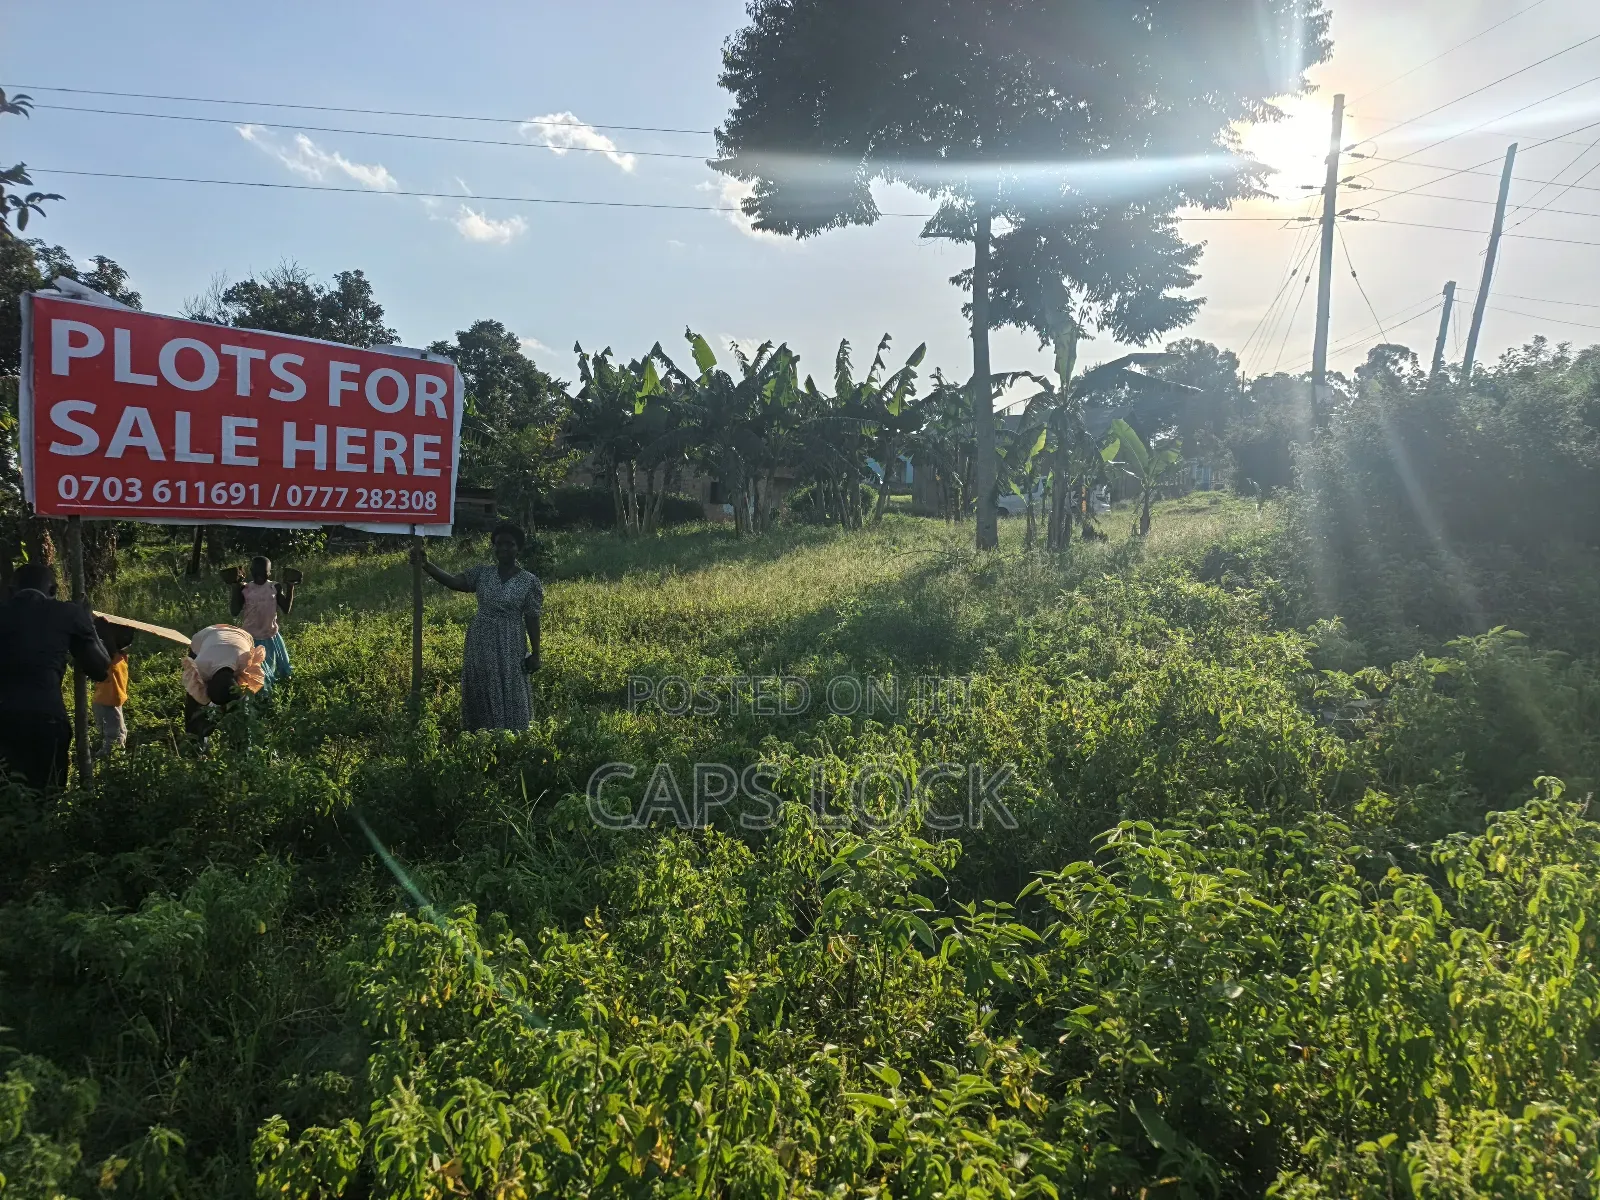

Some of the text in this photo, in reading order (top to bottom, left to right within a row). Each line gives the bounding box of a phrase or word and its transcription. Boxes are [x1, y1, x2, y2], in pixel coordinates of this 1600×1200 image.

[51, 318, 448, 419] PLOTS FOR
[49, 399, 442, 477] SALE HERE
[57, 474, 437, 511] 0703 611691 / 0777 282308
